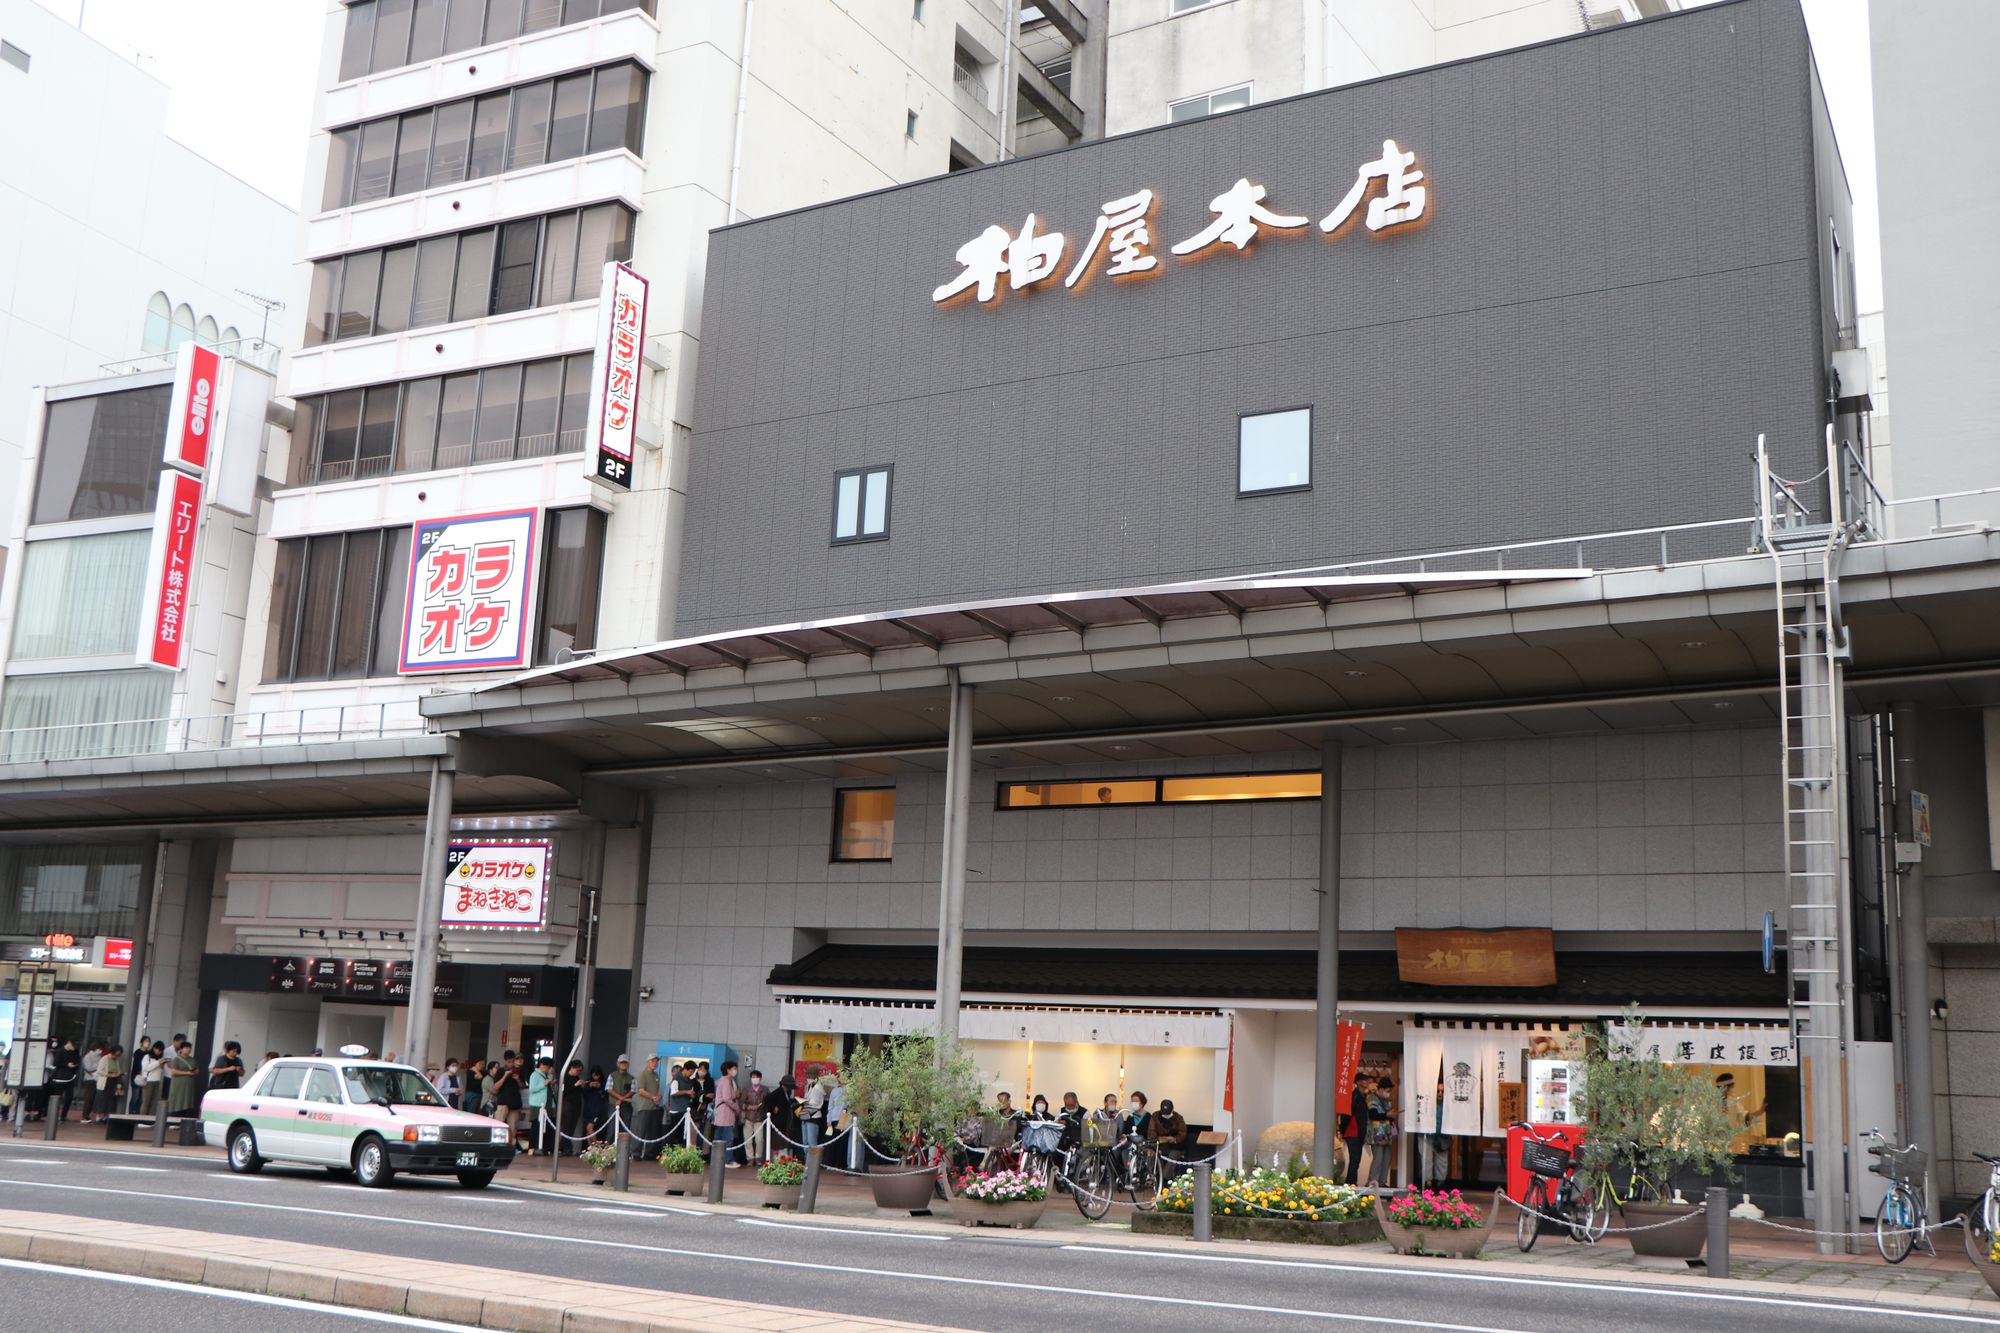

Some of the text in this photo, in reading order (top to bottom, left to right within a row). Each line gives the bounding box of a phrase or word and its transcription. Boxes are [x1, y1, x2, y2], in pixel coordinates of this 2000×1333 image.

[932, 139, 1426, 302] 柏屋本店
[609, 295, 639, 429] カラオケ
[190, 377, 210, 437] elite
[604, 458, 626, 479] 2F
[421, 531, 440, 545] 2F
[160, 500, 193, 643] エリート株式会社
[427, 542, 512, 597] カラ
[421, 599, 507, 653] オケ
[448, 851, 466, 862] 2F
[470, 861, 526, 879] カラオケ
[456, 883, 533, 913] まねきねこ
